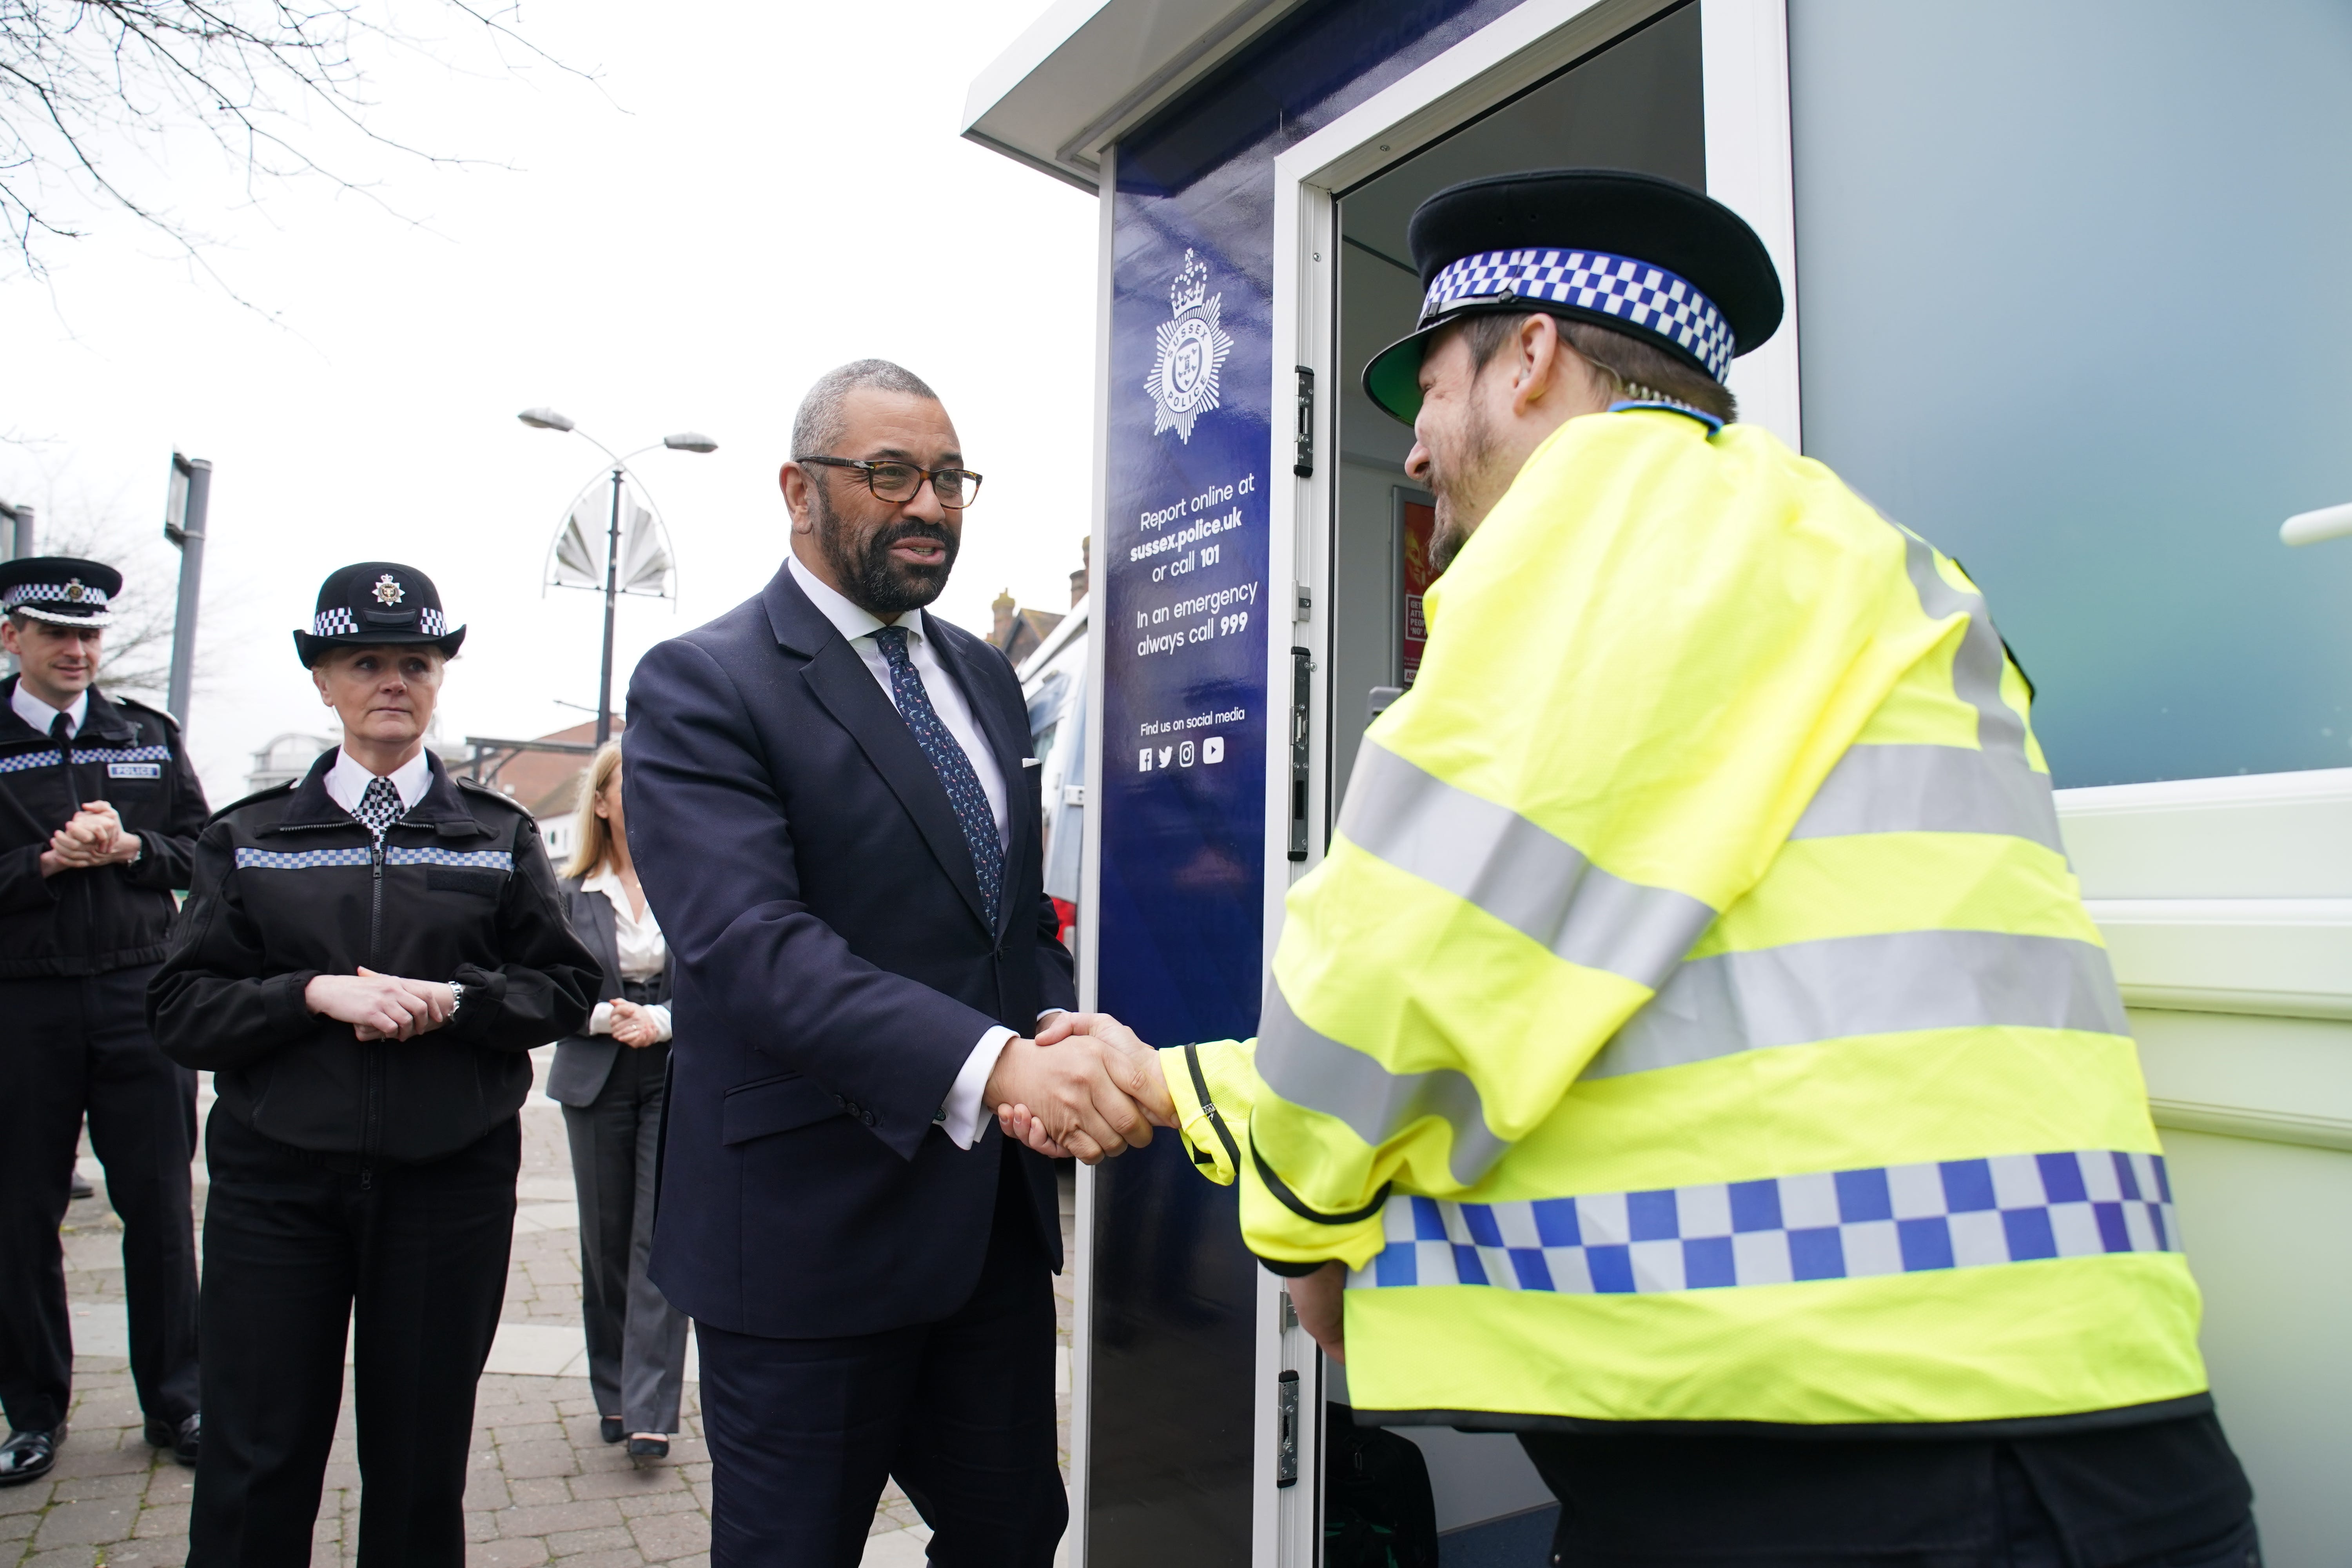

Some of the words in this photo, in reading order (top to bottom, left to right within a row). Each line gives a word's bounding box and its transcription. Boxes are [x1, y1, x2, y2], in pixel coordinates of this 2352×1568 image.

[1168, 324, 1207, 359] SUSSEX
[1167, 375, 1207, 407] POLICE
[1141, 499, 1186, 531] Report
[1191, 485, 1233, 512] online
[1238, 473, 1254, 495] at
[1131, 506, 1242, 562] sussex.police.uk
[1152, 565, 1167, 582] or
[1171, 550, 1194, 576] call
[1201, 544, 1219, 567] 101
[1137, 611, 1148, 628] In
[1152, 607, 1169, 624] an
[1174, 581, 1258, 614] emergency
[1138, 632, 1184, 656] always
[1189, 618, 1214, 643] call
[1221, 612, 1248, 636] 999
[1141, 720, 1158, 736] Find
[1161, 722, 1171, 732] us
[1173, 720, 1184, 730] on
[1187, 711, 1212, 728] social
[1215, 707, 1245, 724] media
